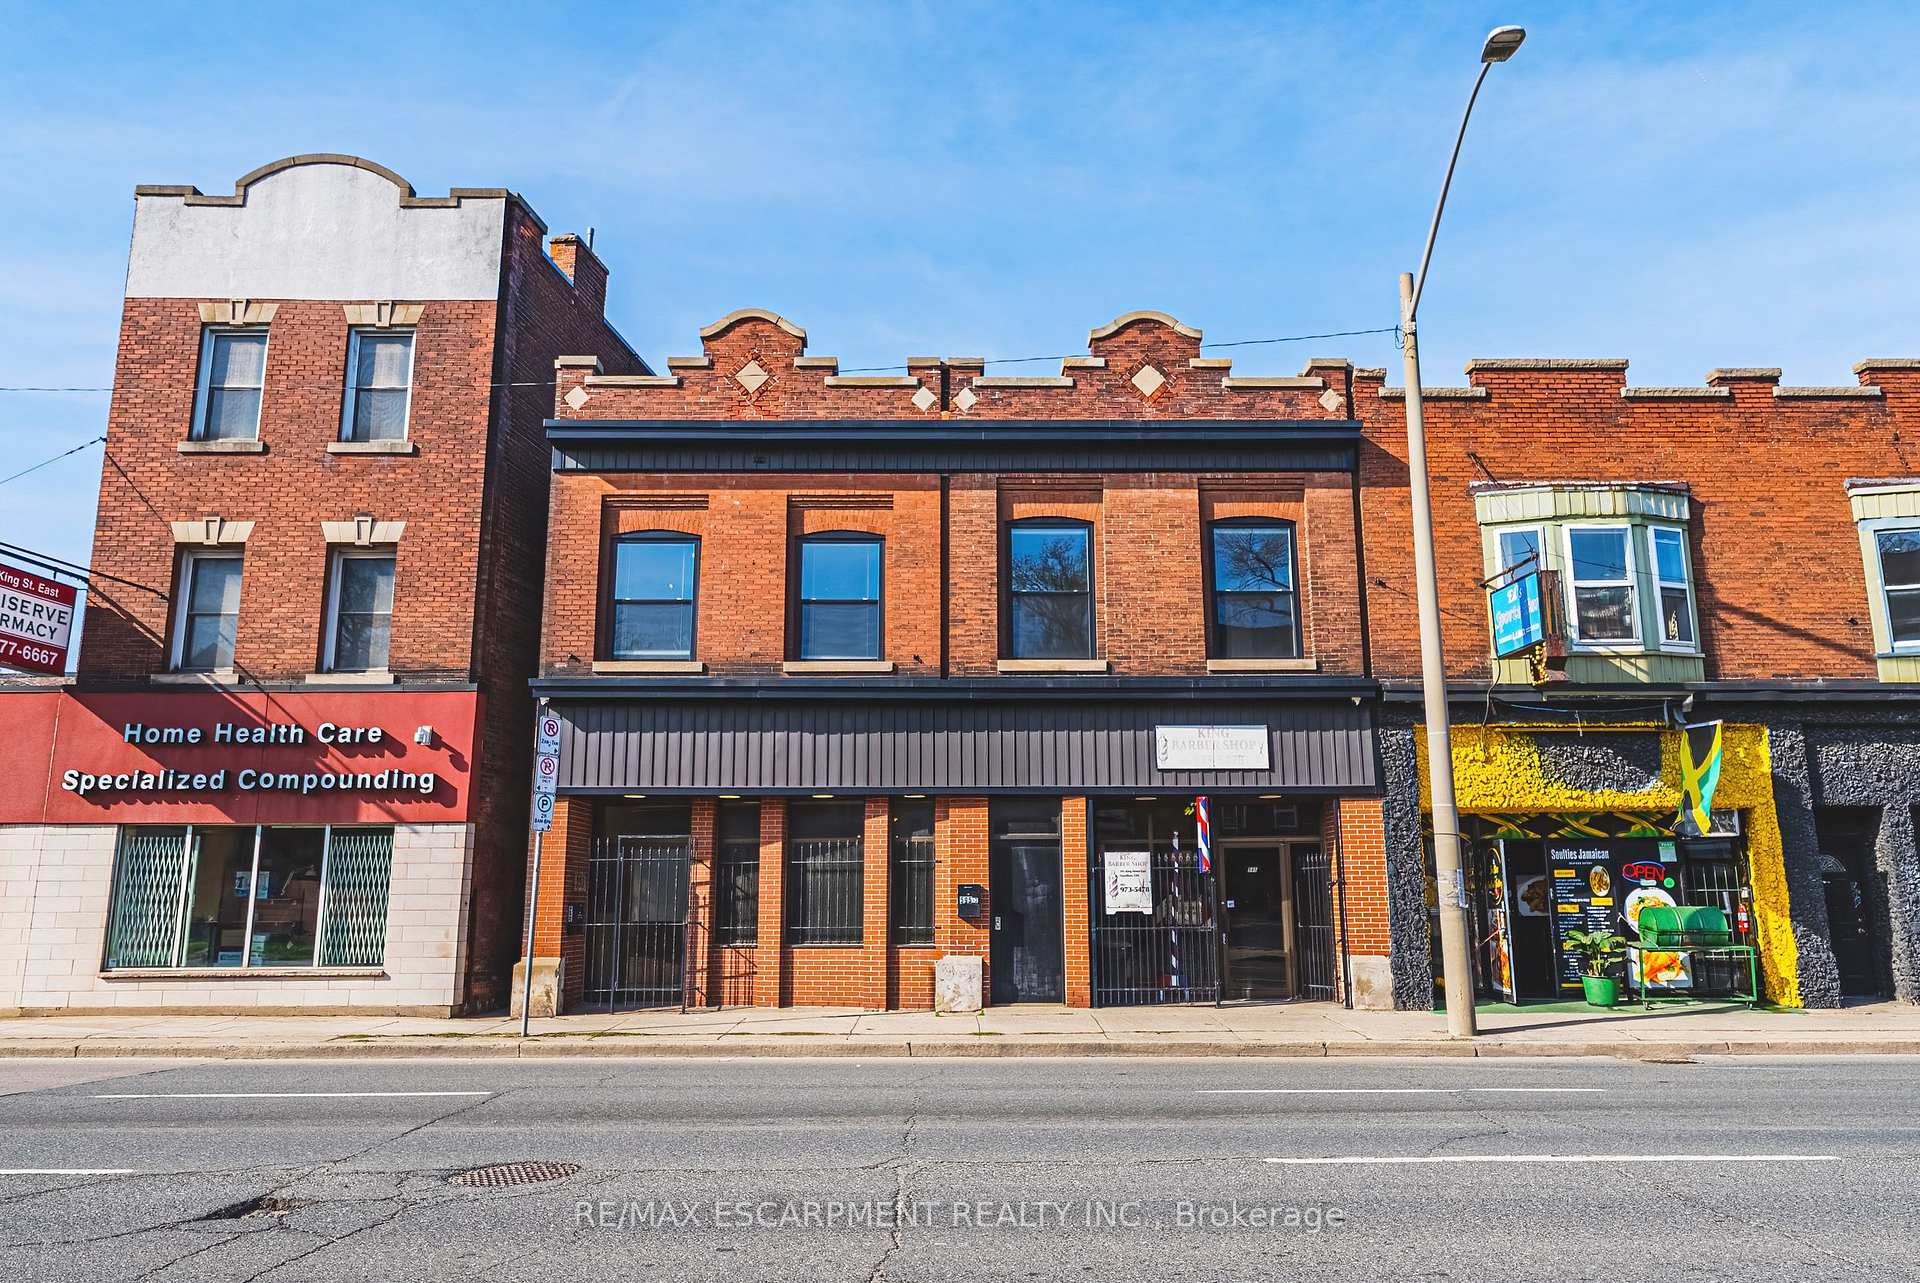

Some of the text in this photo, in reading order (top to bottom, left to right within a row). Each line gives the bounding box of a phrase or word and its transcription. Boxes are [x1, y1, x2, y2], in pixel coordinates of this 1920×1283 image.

[22, 578, 35, 591] St.
[38, 583, 60, 598] East
[123, 722, 382, 744] Home Health Care
[1197, 729, 1231, 739] KING
[1171, 740, 1257, 751] BARBER SHOP
[62, 769, 435, 795] Specialized Compounding
[1578, 848, 1610, 860] Jamaican
[1622, 864, 1666, 882] OPEN
